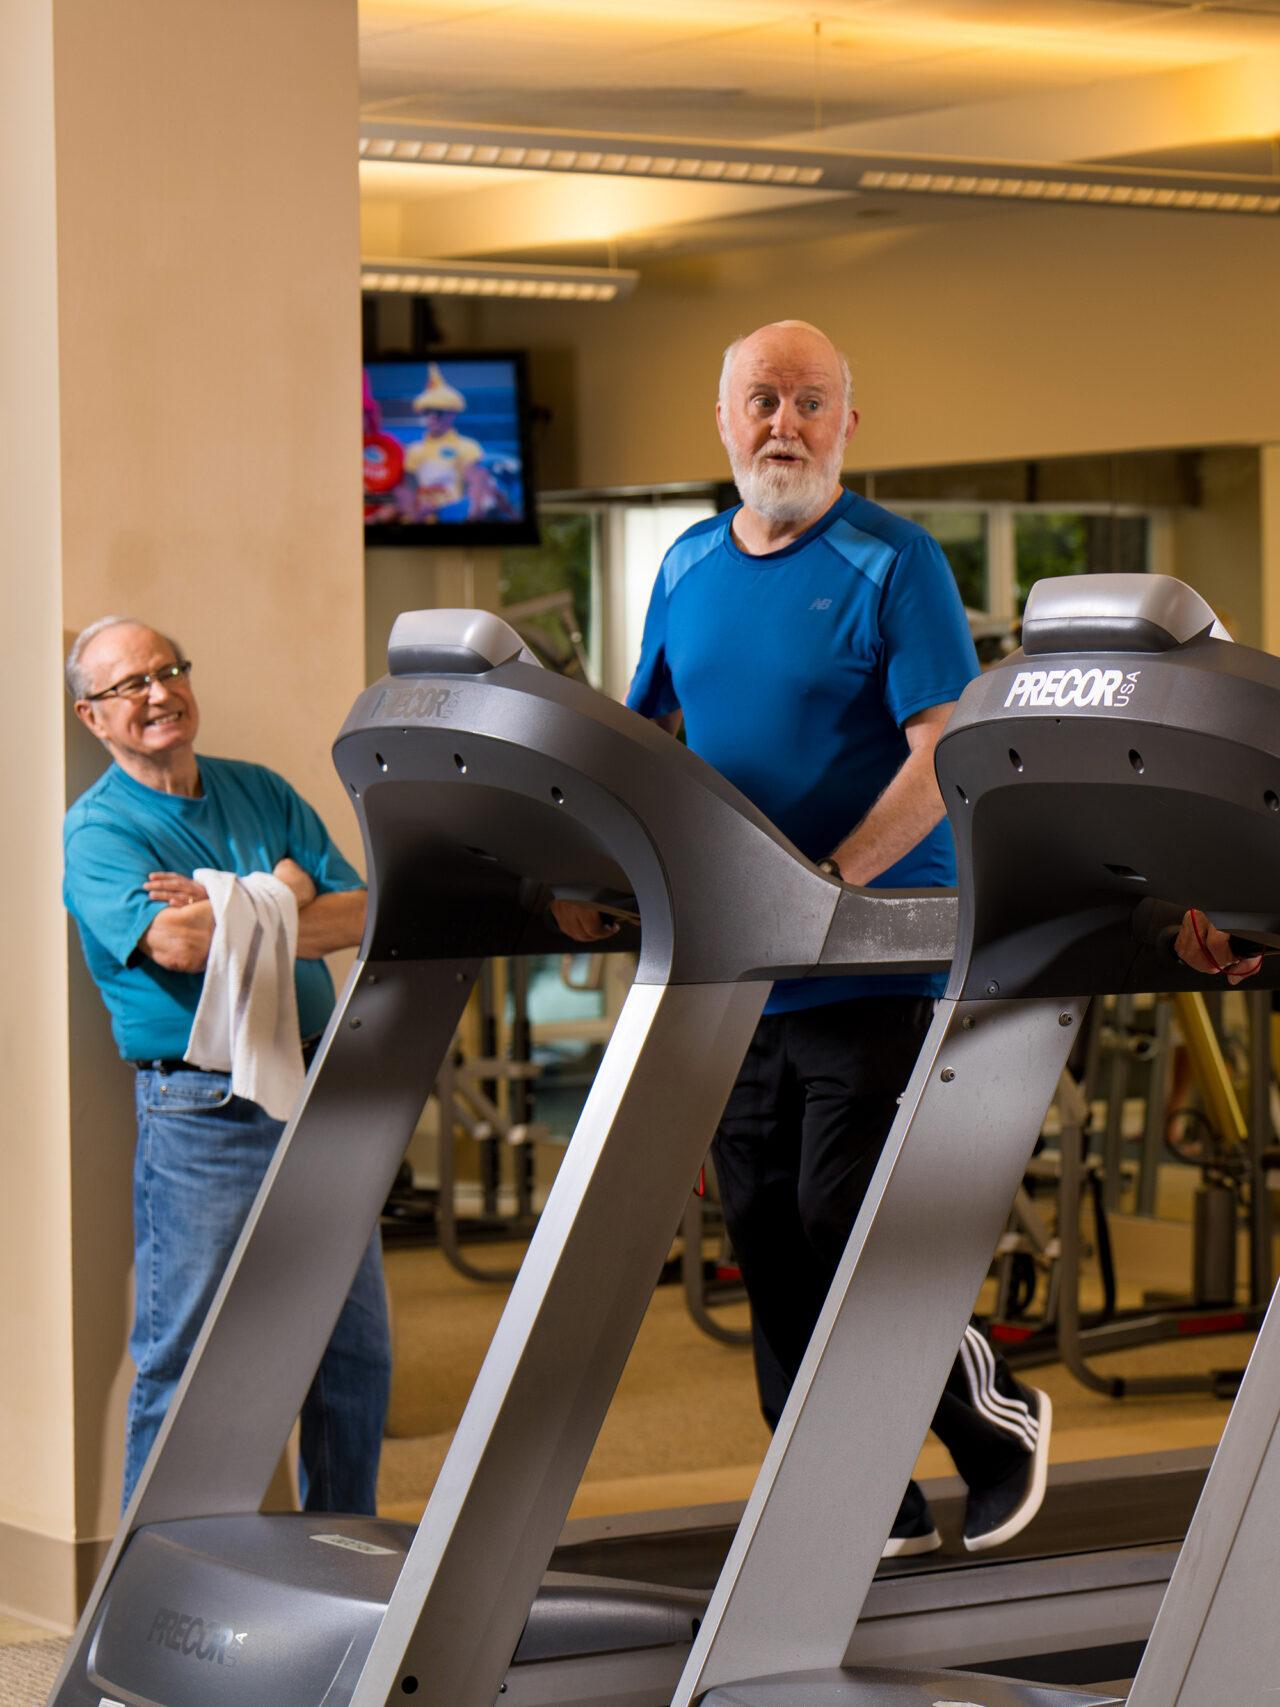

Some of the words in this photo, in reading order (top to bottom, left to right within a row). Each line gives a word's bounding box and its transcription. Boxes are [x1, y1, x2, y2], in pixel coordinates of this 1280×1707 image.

[808, 598, 832, 610] NB
[1003, 668, 1123, 707] PRECOR
[1113, 670, 1141, 707] USA
